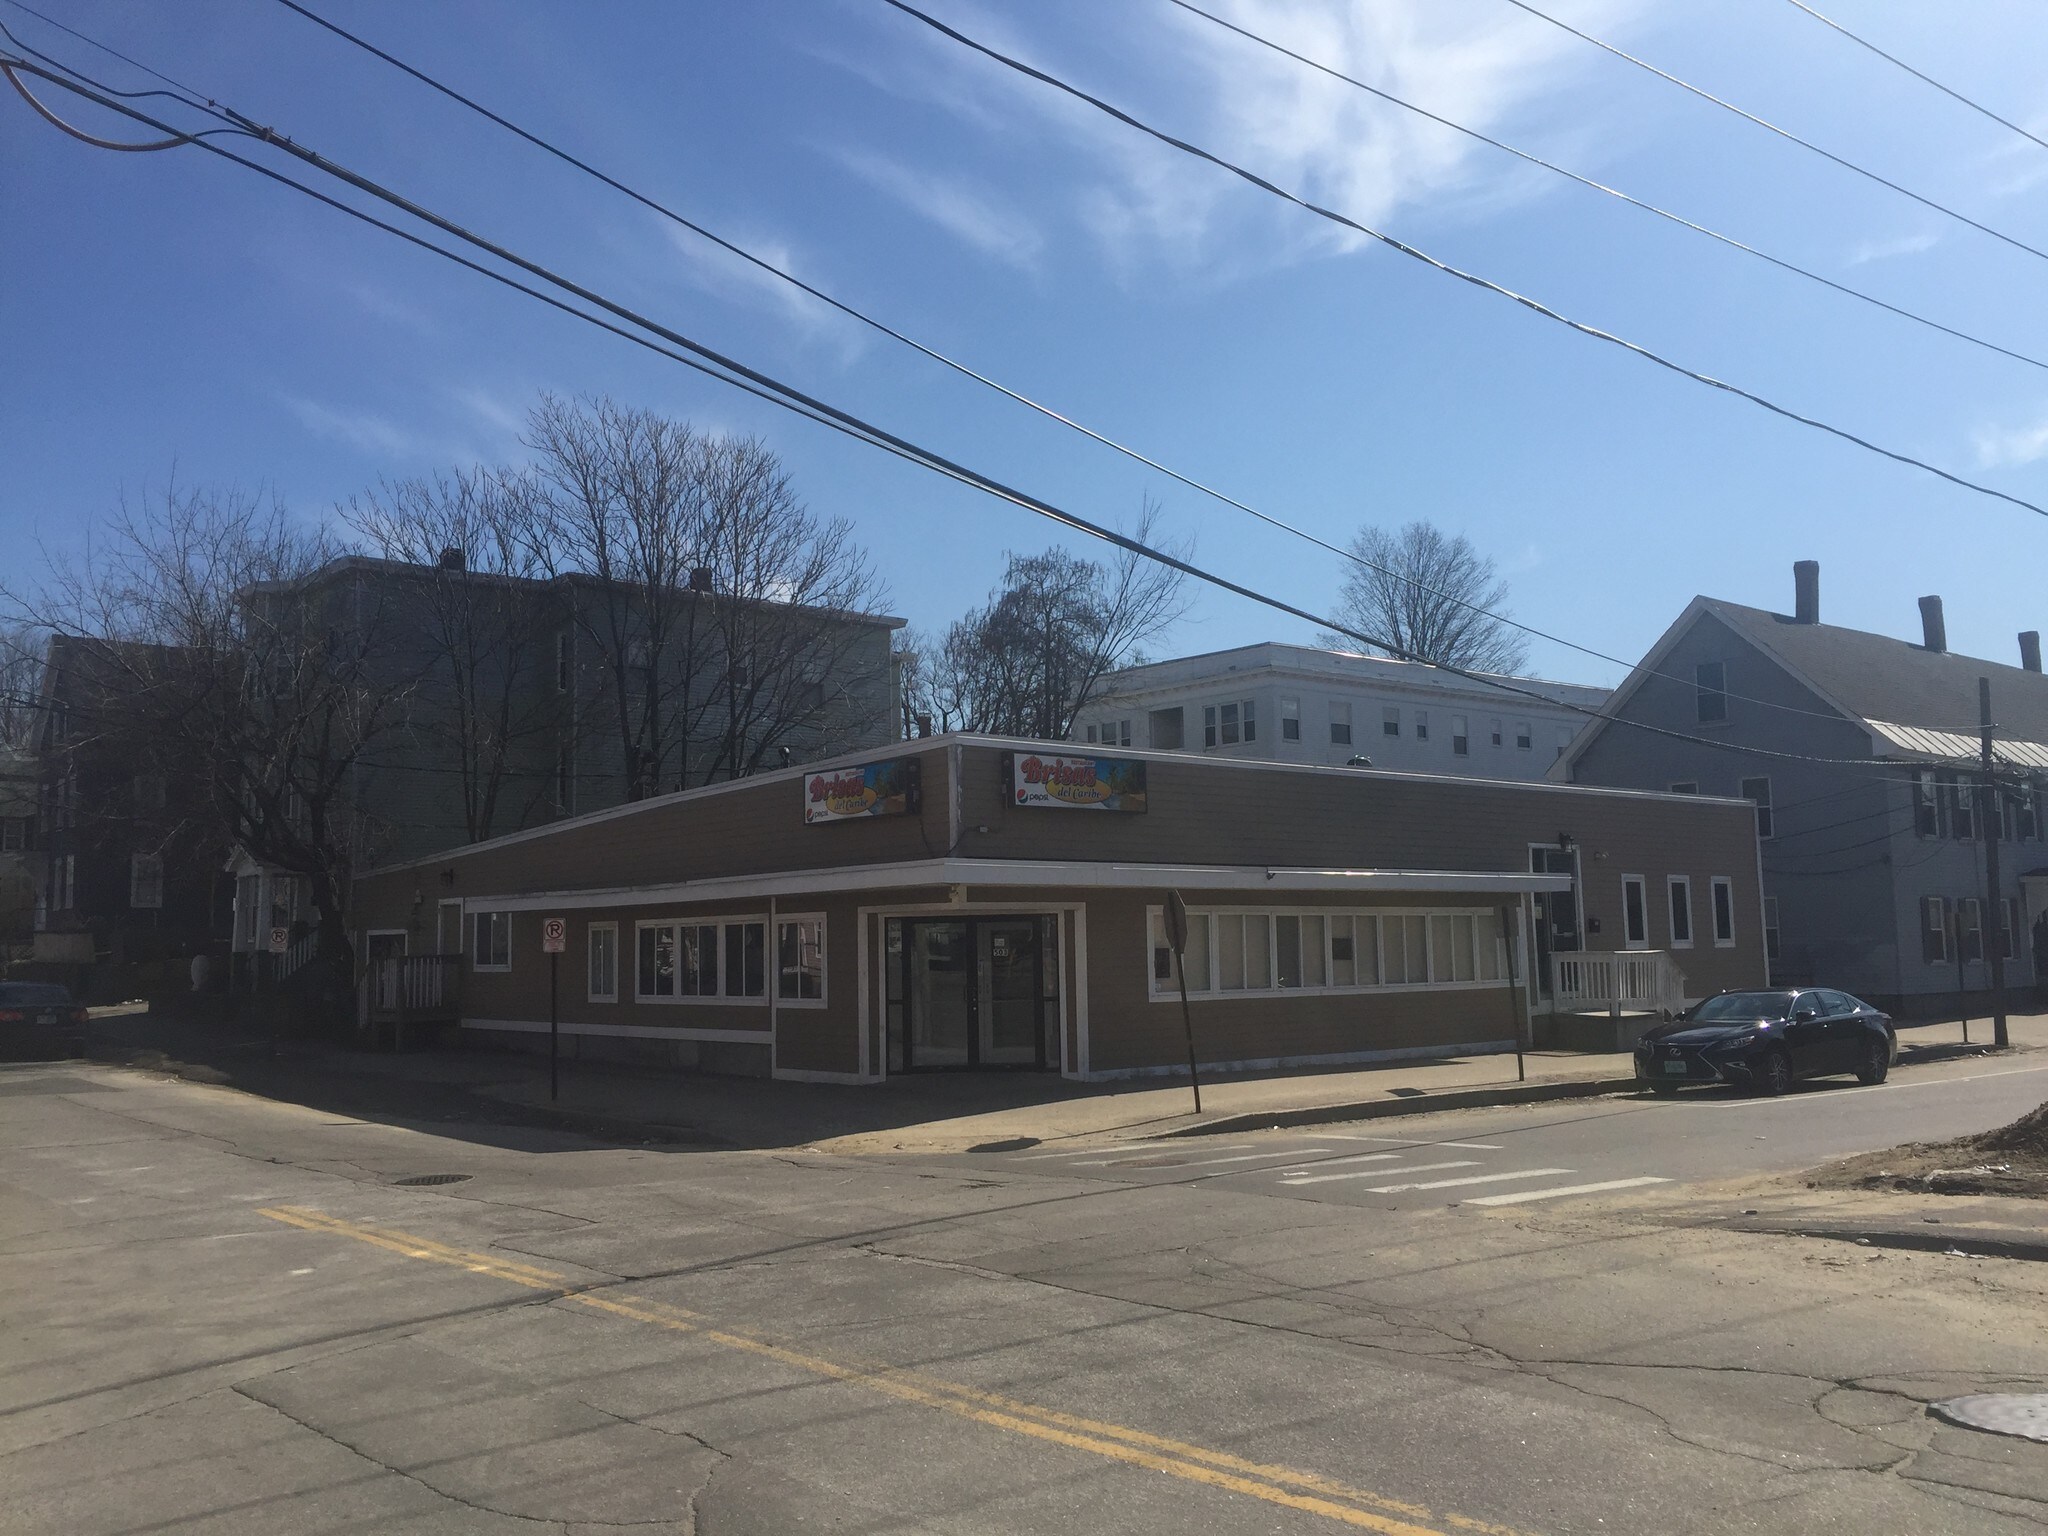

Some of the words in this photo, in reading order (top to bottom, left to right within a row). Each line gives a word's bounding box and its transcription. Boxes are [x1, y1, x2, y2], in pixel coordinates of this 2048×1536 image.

[1020, 755, 1097, 787] Brisas
[809, 773, 864, 803] Brisas
[1029, 793, 1050, 802] pepsi
[1057, 787, 1071, 797] del
[1073, 788, 1102, 800] Caribe
